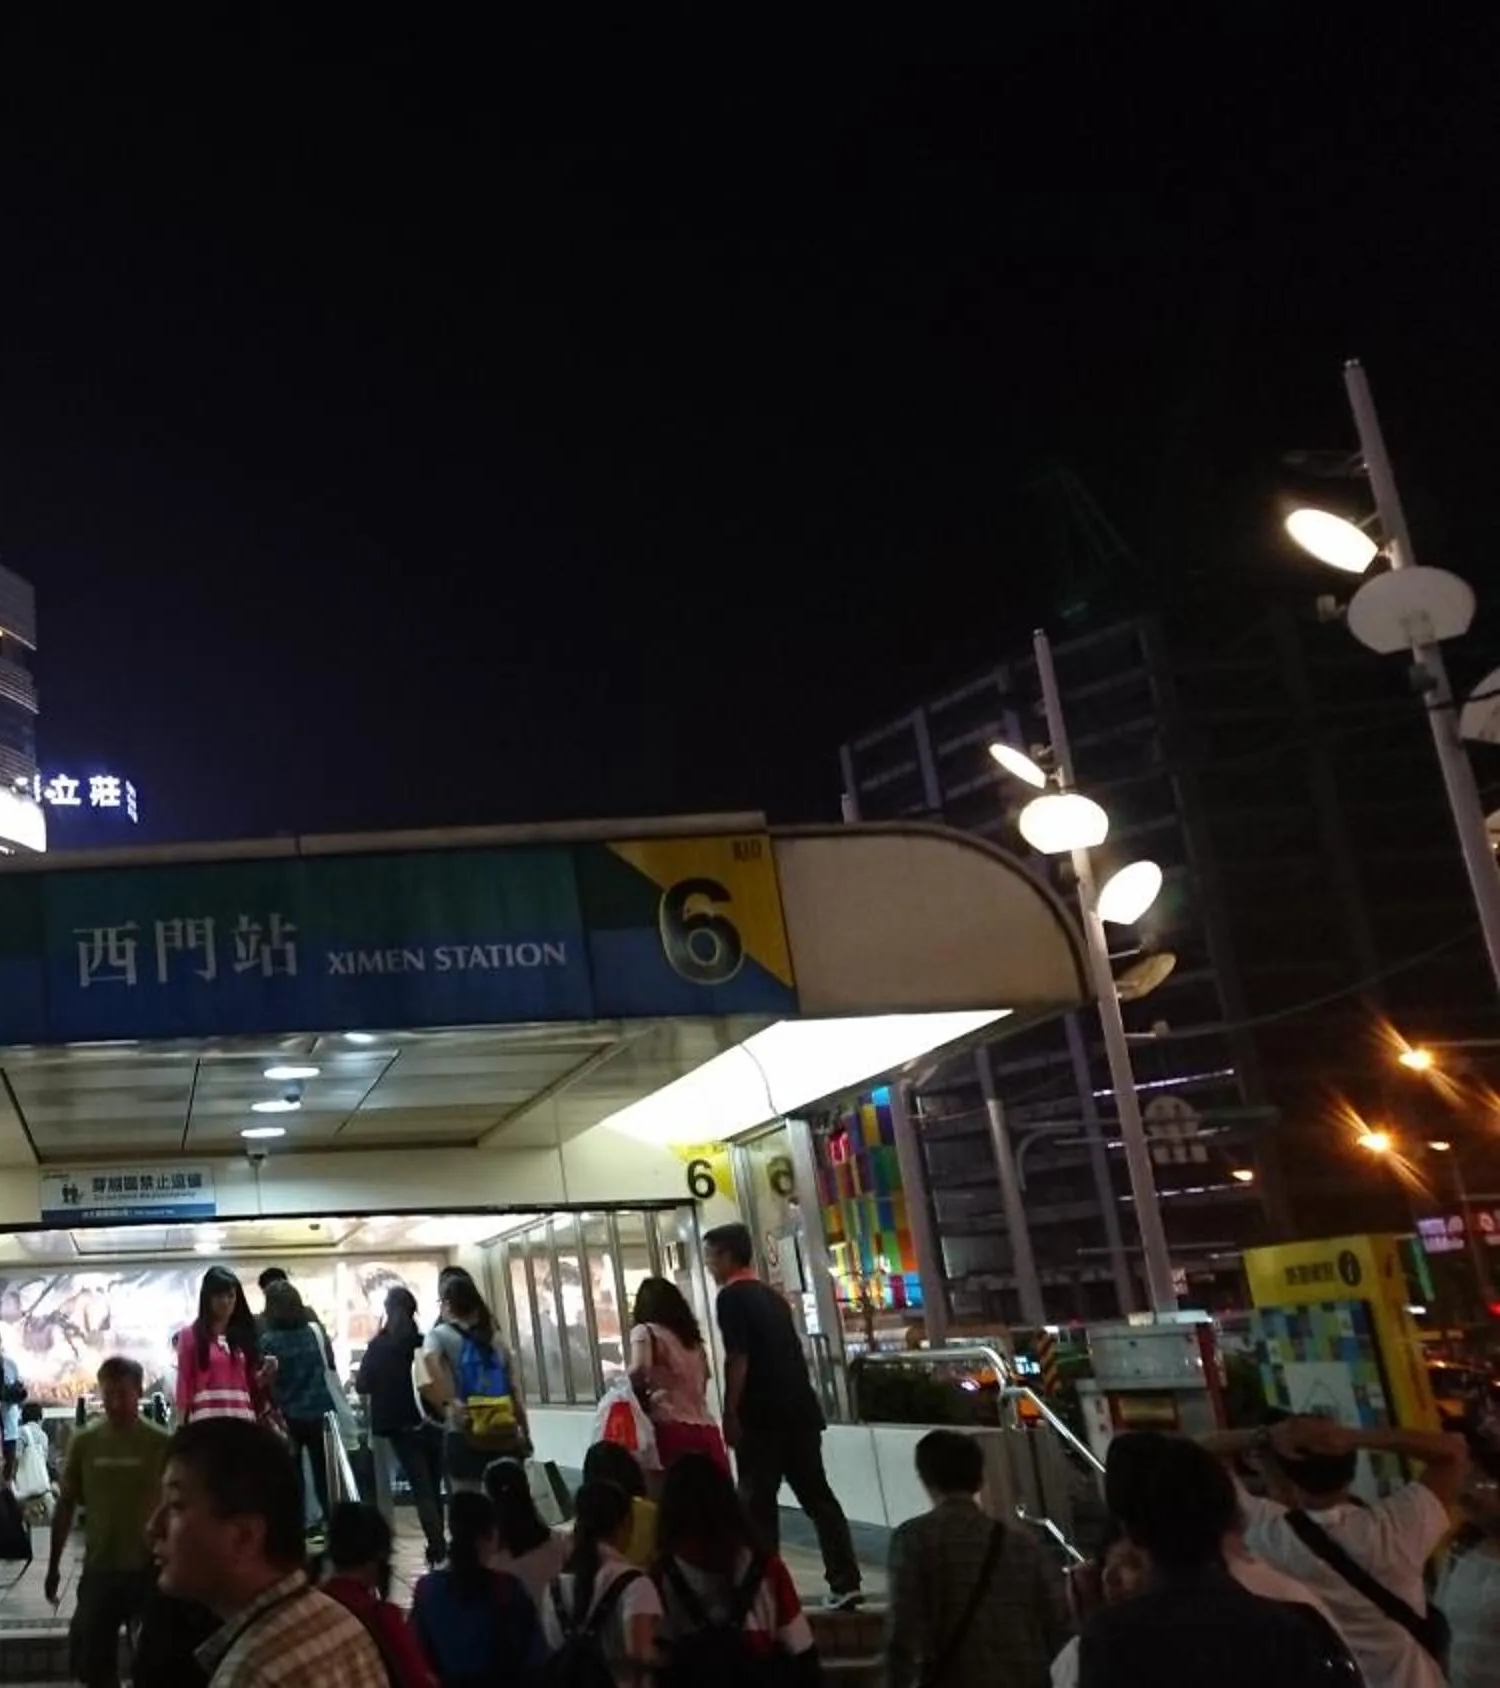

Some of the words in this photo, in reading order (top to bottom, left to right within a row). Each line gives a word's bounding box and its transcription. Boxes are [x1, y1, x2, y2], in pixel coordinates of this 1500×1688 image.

[72, 913, 299, 988] 西門站
[327, 948, 426, 976] XIMEN
[434, 940, 568, 970] STATION
[659, 877, 745, 986] 6
[687, 1158, 717, 1199] 6
